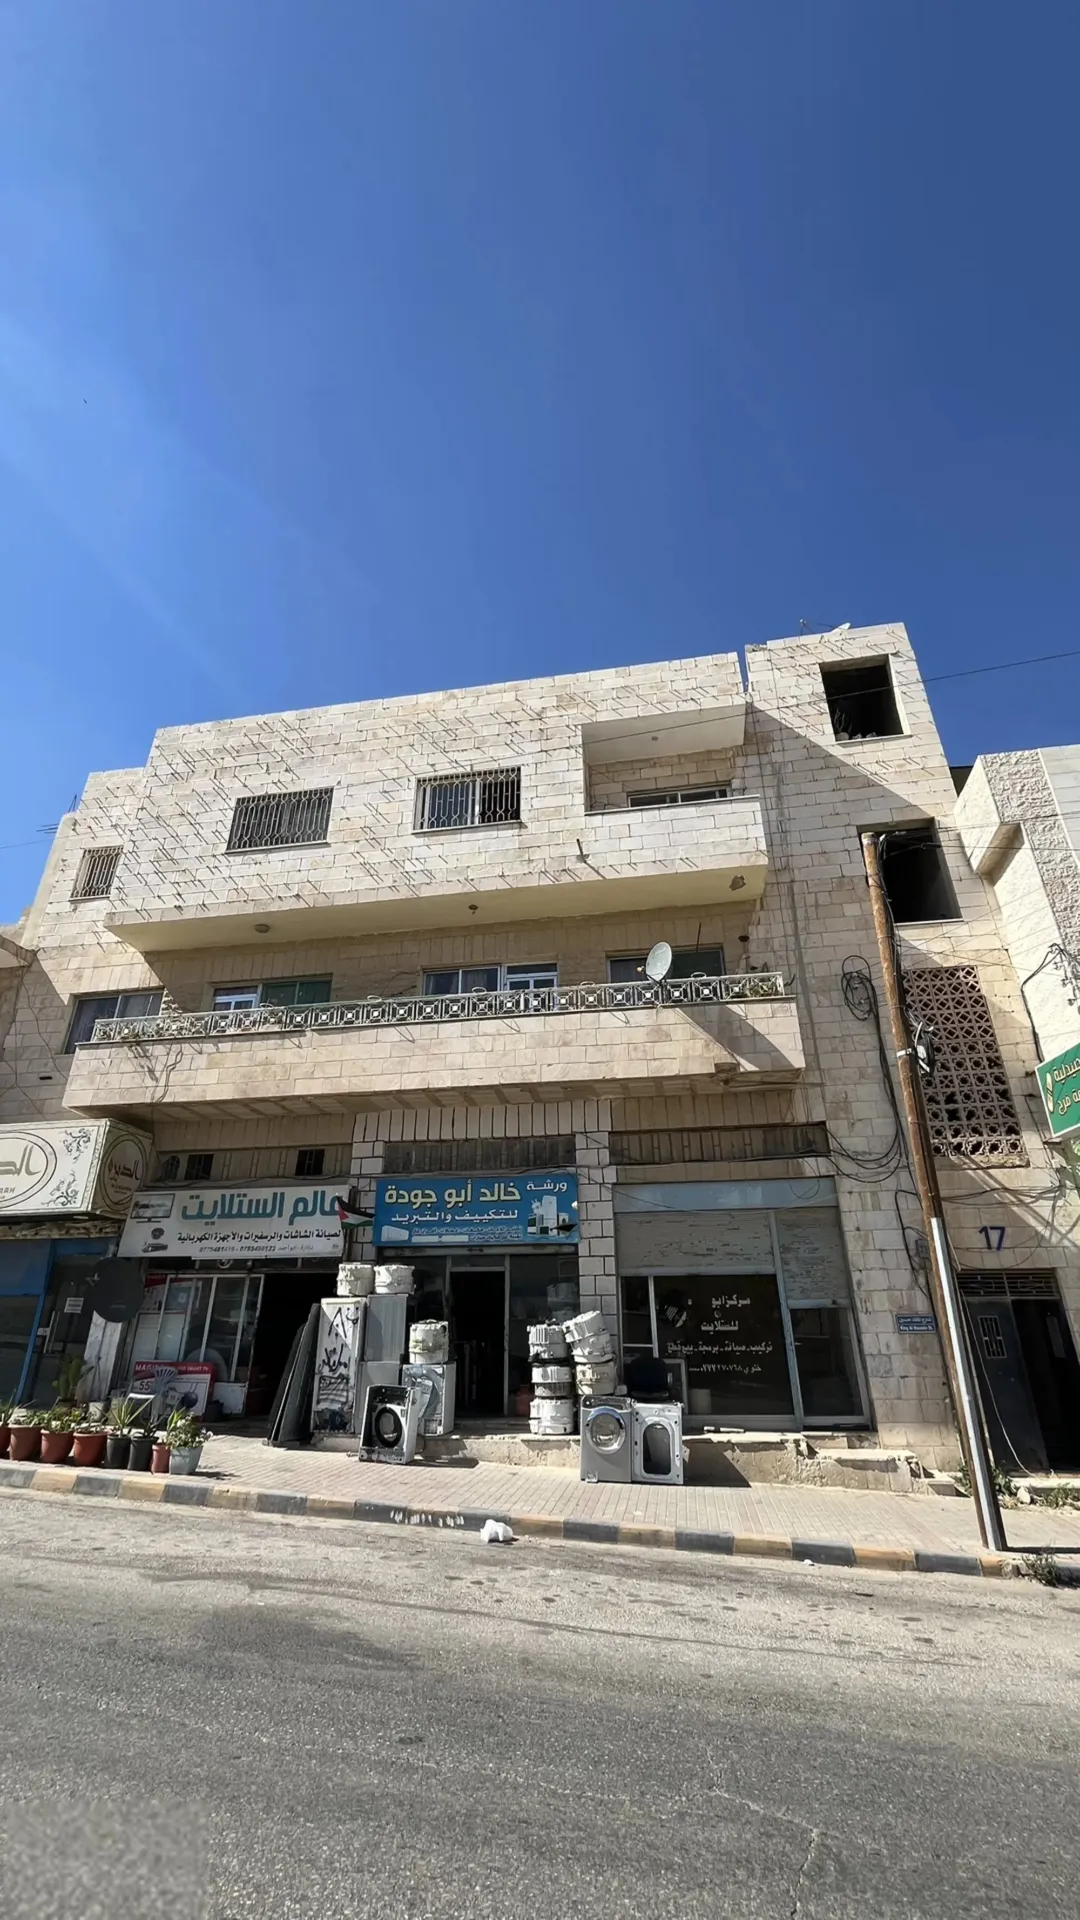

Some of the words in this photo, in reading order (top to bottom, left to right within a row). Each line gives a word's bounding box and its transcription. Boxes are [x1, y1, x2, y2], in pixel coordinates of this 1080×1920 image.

[479, 1182, 521, 1202] خالد
[526, 1179, 568, 1192] ورشة
[384, 1185, 438, 1209] جودة
[444, 1179, 472, 1208] أبو
[181, 1192, 285, 1226] الستلايت
[288, 1190, 339, 1226] عالم
[391, 1211, 452, 1224] والتبريد
[454, 1209, 518, 1224] للتكييف
[244, 1231, 282, 1243] والرسفيرات
[283, 1229, 314, 1239] الشاشات
[315, 1229, 341, 1240] لصيانة
[979, 1226, 1005, 1251] 17
[711, 1295, 725, 1308] ابو
[725, 1294, 751, 1308] مركز
[700, 1320, 739, 1335] للستلايت
[698, 1341, 719, 1354] برمجة
[724, 1341, 746, 1355] صيانة
[749, 1341, 773, 1354] تركيب
